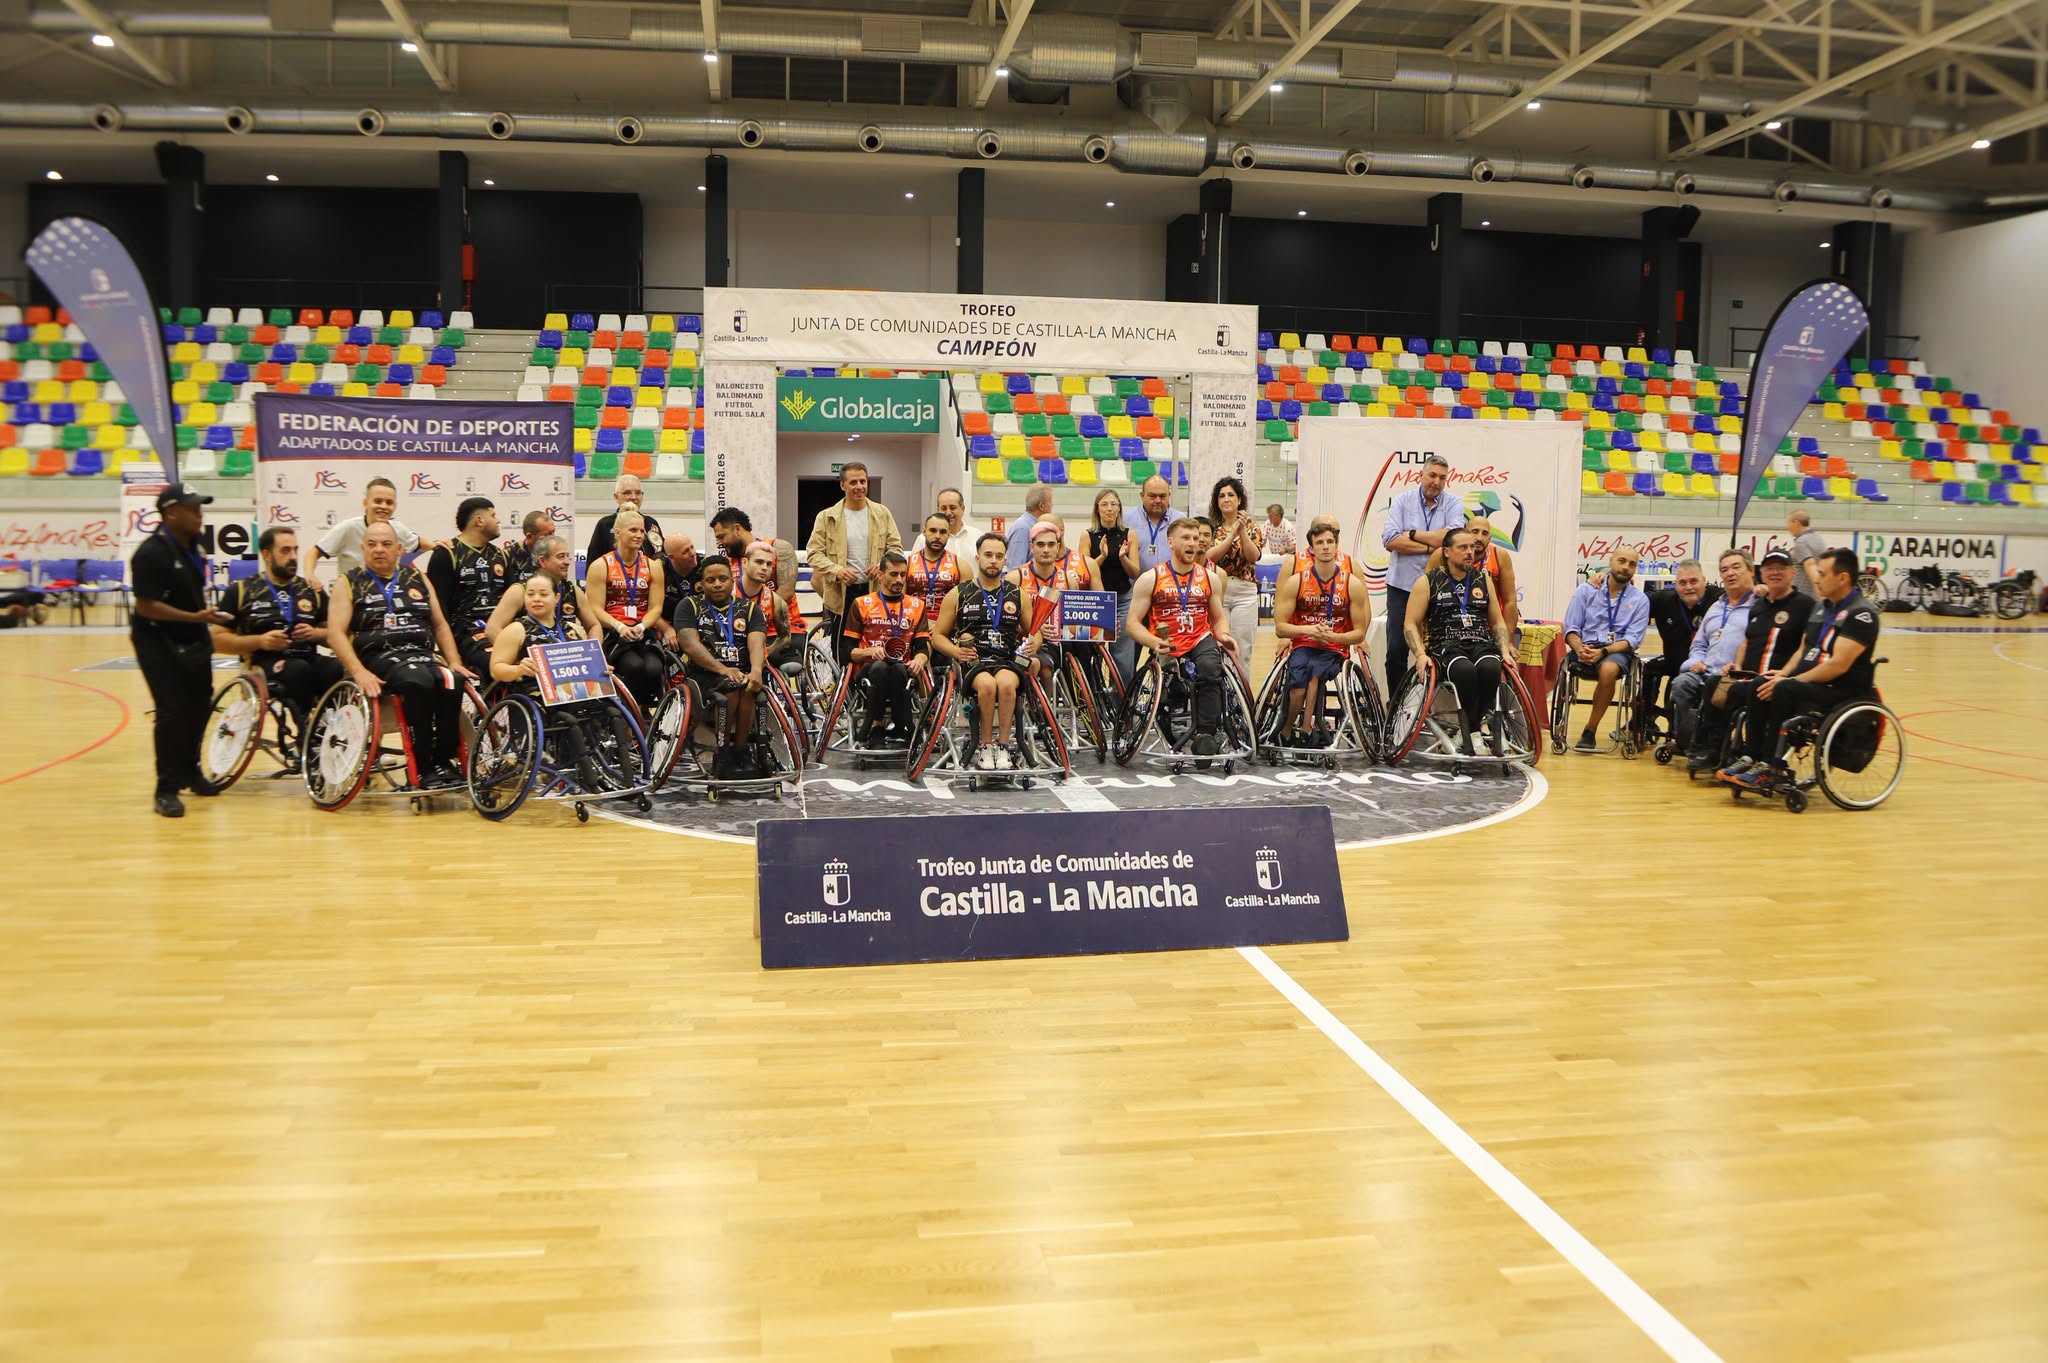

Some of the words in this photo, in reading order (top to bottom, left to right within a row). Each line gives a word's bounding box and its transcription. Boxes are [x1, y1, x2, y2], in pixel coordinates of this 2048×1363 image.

[960, 303, 1016, 317] TROFEO
[791, 317, 841, 333] JUNTA
[845, 318, 865, 332] DE
[869, 318, 988, 335] COMUNIDADES
[992, 322, 1011, 336] DE
[1016, 323, 1107, 339] CASTILLA-LA
[1111, 326, 1177, 342] MANCHA
[713, 334, 746, 343] Castilla-La
[746, 335, 768, 344] Mancha
[936, 338, 1037, 358] CAMPEÓN
[1197, 347, 1227, 357] Castilla-La
[1227, 349, 1248, 358] Mancha
[715, 383, 764, 391] BALONCESTO
[716, 391, 763, 400] BALONMANO
[1202, 393, 1247, 401] BALONCESTO
[725, 401, 754, 409] FUTBOL
[1203, 402, 1246, 410] BALONMANO
[714, 410, 744, 418] FUTBOL
[745, 410, 765, 419] SALA
[820, 396, 935, 428] Globalcaja
[1211, 411, 1237, 419] FUTBOL
[278, 412, 420, 436] FEDERACIÓN
[425, 419, 453, 436] DE
[459, 419, 560, 437] DEPORTES
[1200, 420, 1227, 428] FUTBOL
[278, 436, 373, 452] ADAPTADOS
[377, 438, 399, 453] DE
[402, 440, 493, 454] CASTILLA-LA
[496, 441, 560, 455] MANCHA
[1064, 611, 1090, 620] 3.000
[1092, 612, 1098, 620] €
[545, 647, 568, 656] TROFEO
[551, 666, 580, 679] 1.500
[581, 664, 589, 675] €
[917, 857, 976, 877] Trofeo
[980, 855, 1026, 876] Junta
[1030, 852, 1052, 874] de
[1056, 851, 1169, 873] Comunidades
[1172, 850, 1194, 869] de
[920, 883, 1026, 917] Castilla
[1048, 881, 1081, 912] La
[1087, 877, 1198, 910] Mancha
[1225, 894, 1281, 908] Castilla-La
[1281, 893, 1321, 907] Mancha
[784, 910, 847, 924] Castilla-La
[848, 909, 891, 923] Mancha
